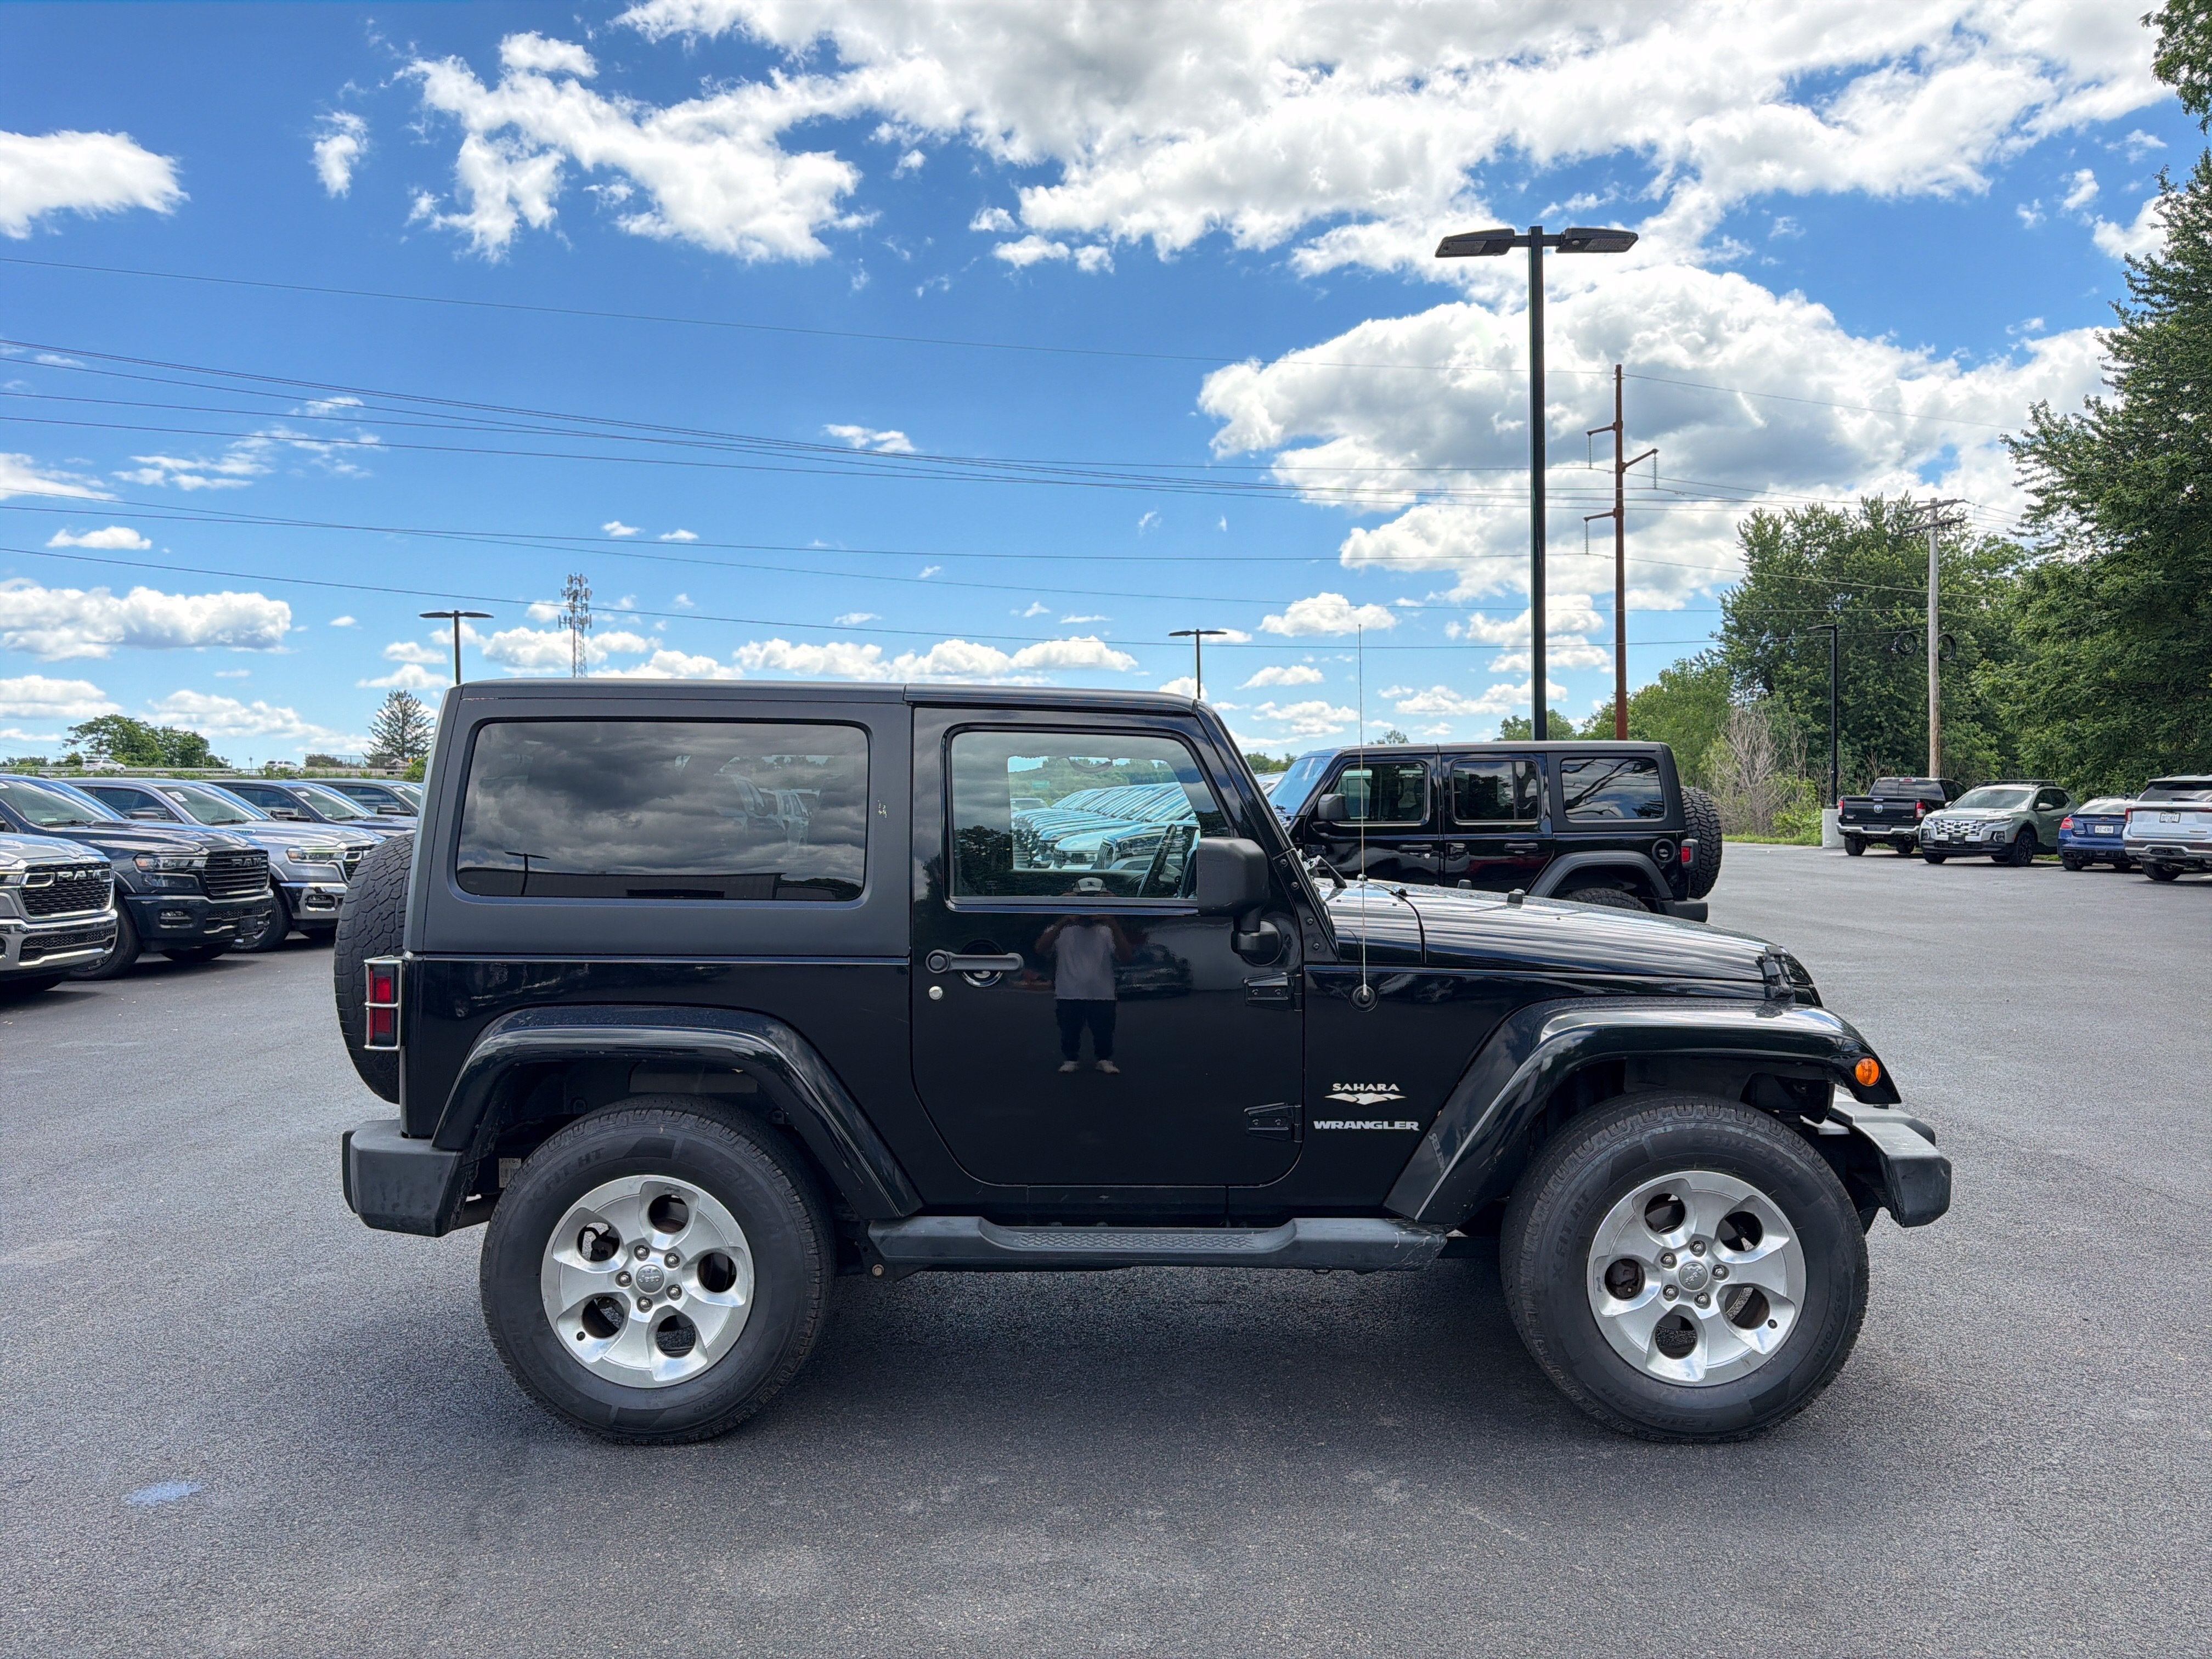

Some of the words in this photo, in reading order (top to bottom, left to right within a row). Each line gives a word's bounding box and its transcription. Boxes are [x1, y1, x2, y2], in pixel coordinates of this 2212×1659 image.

[231, 857, 262, 867] RAM
[57, 868, 101, 883] RAM
[1332, 1083, 1400, 1092] SAHARA
[1313, 1120, 1420, 1131] WRANGLER
